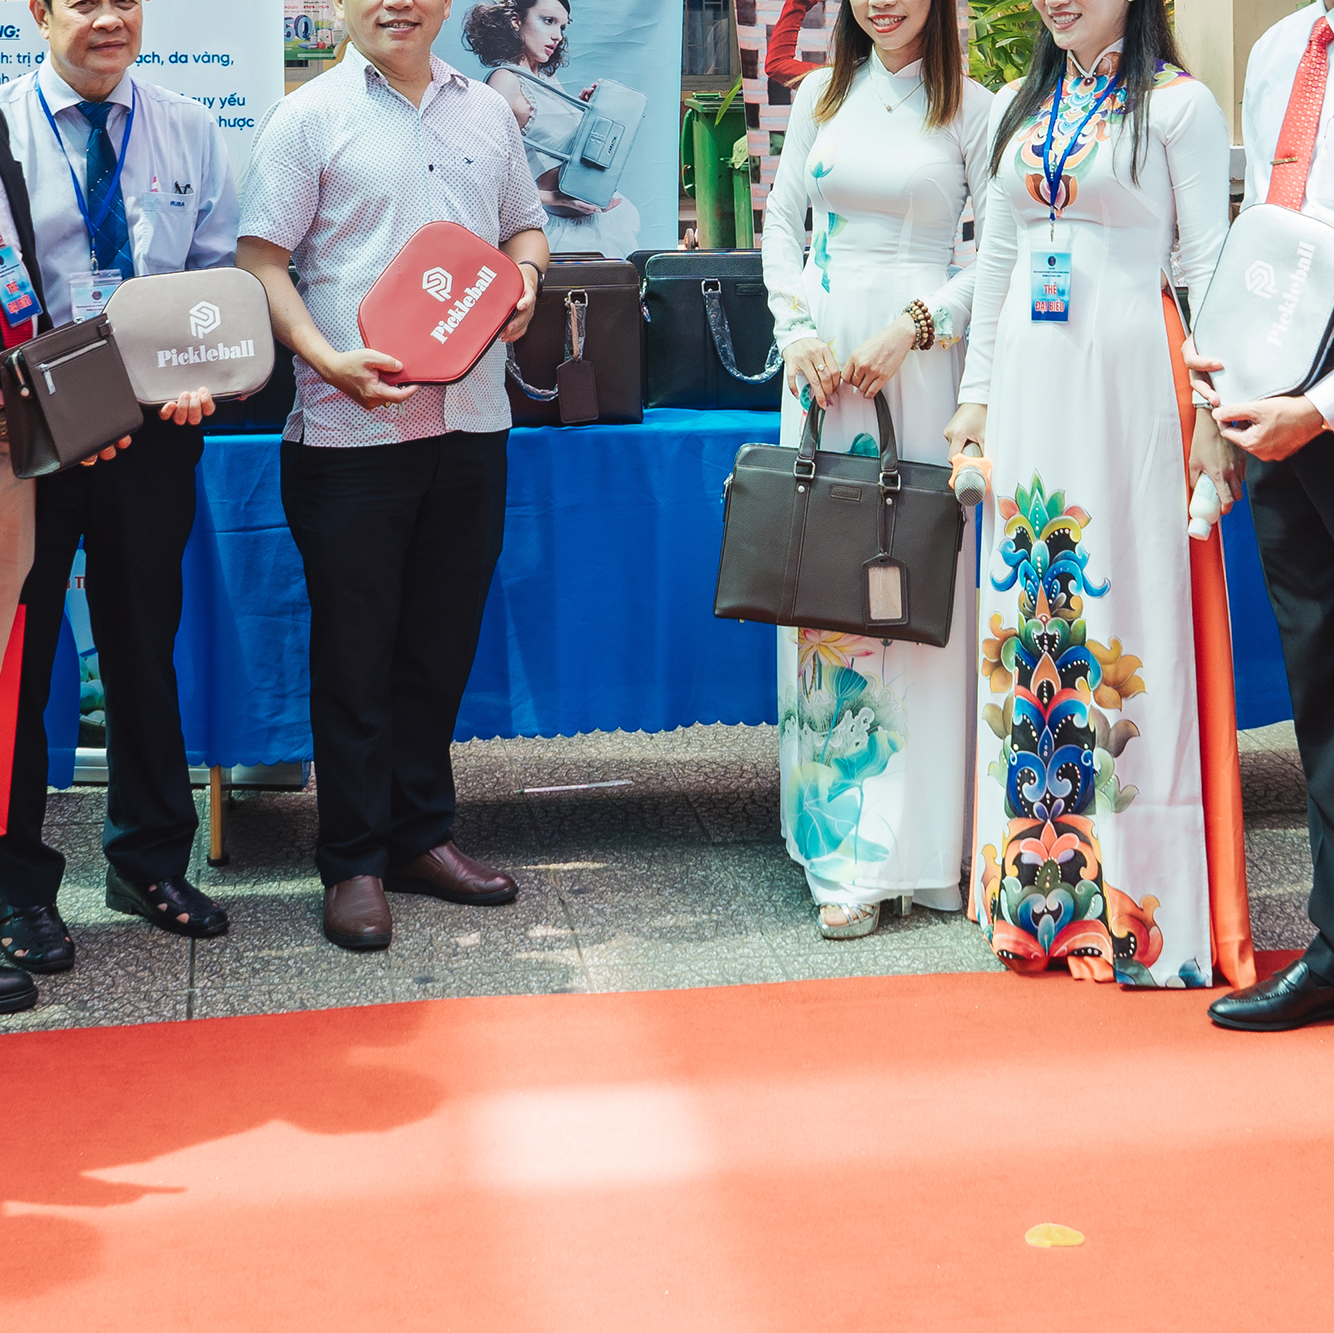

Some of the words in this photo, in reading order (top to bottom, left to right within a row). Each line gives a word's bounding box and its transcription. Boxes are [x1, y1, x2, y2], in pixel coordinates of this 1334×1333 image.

[16, 51, 31, 67] trị
[168, 51, 189, 64] da
[192, 51, 235, 67] vàng,
[219, 92, 246, 109] yếu
[216, 115, 255, 131] hược
[1266, 240, 1316, 348] Pickleball
[430, 265, 498, 345] Pickleball
[1035, 301, 1048, 314] ĐẠI
[156, 339, 255, 368] Pickleball
